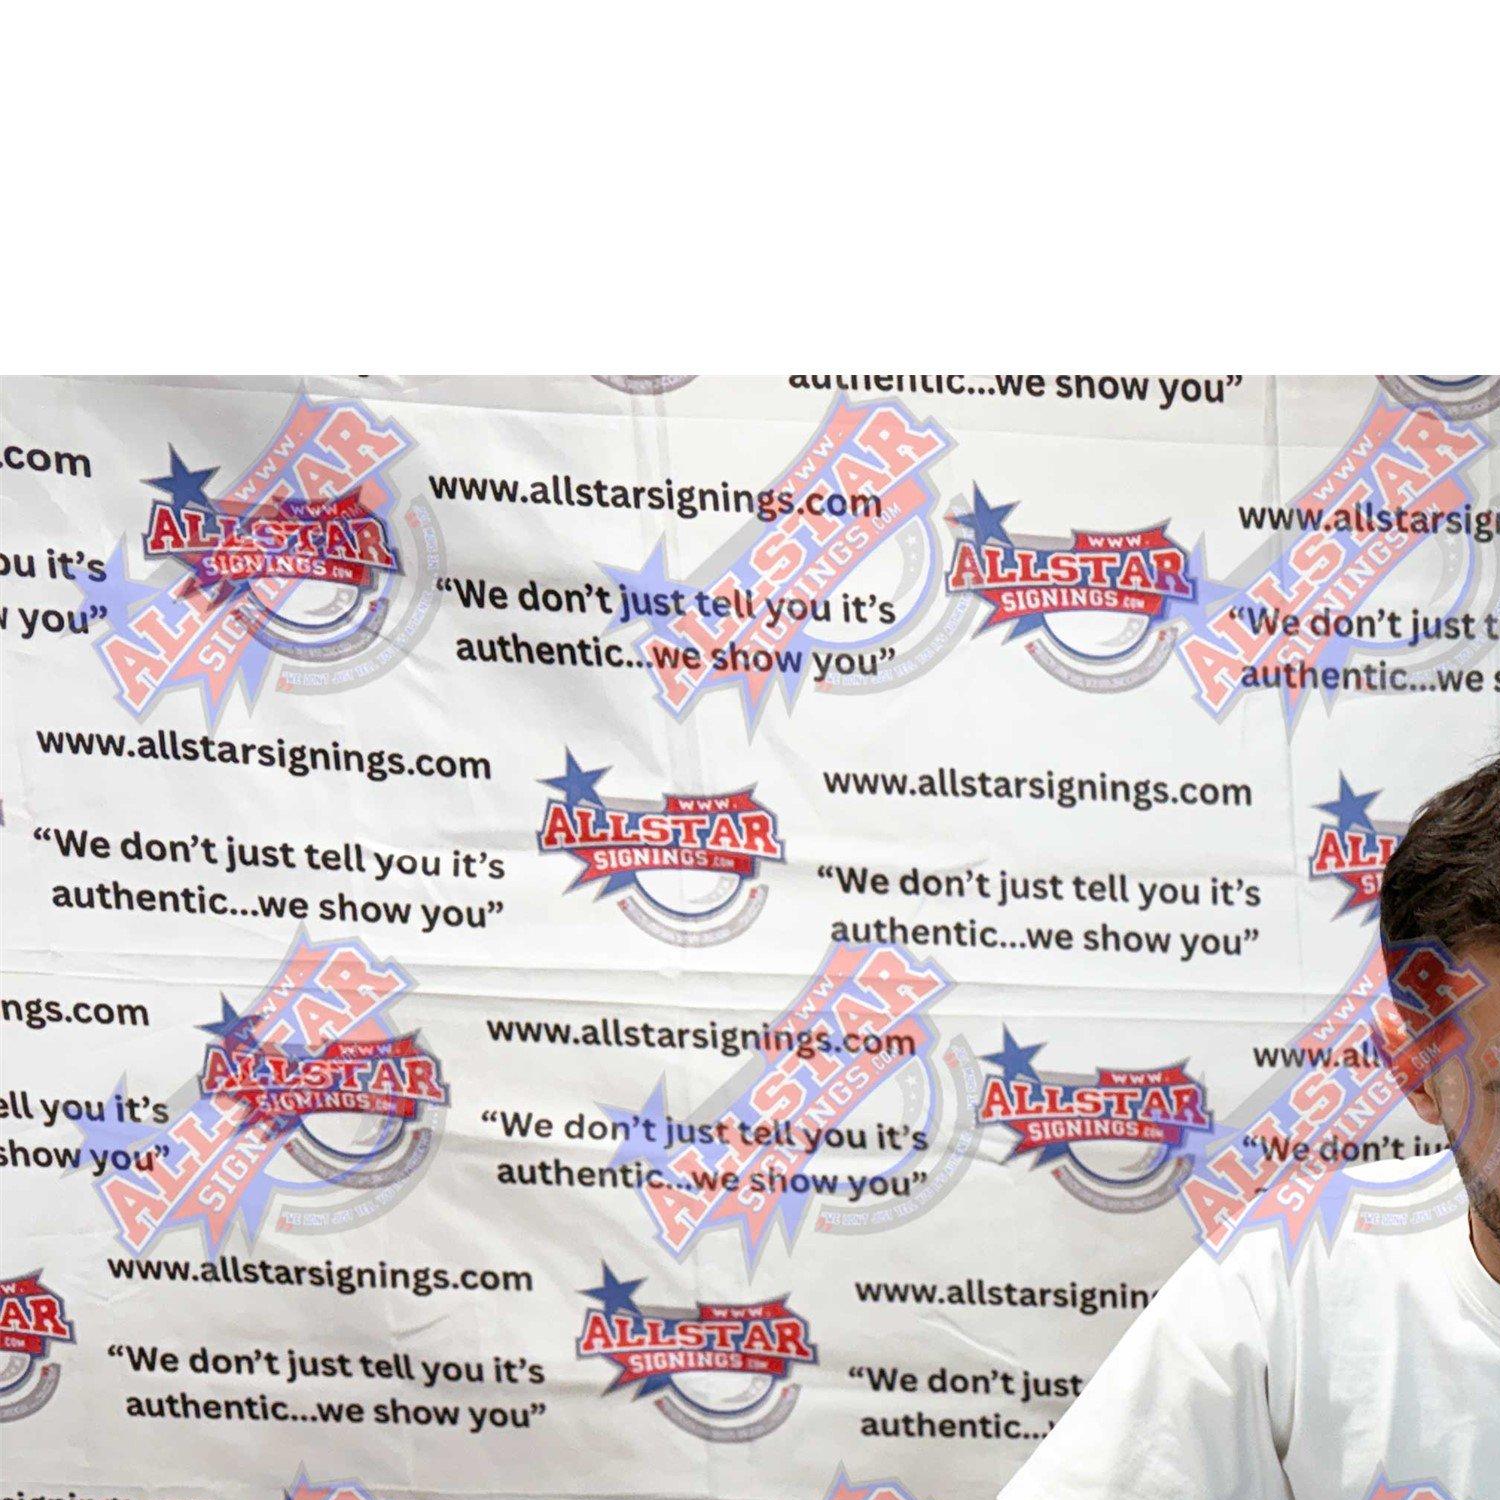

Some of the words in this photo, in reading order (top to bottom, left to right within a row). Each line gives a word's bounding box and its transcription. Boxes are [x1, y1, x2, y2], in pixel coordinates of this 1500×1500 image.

[428, 474, 882, 522] www.allstarsignings.com
[947, 541, 1194, 600] ALLSTAR
[823, 767, 1252, 811] www.allstarsignings.com
[541, 803, 782, 858] ALLSTAR
[998, 875, 1063, 906] just
[1072, 874, 1129, 902] tell
[1138, 882, 1199, 911] you
[1084, 923, 1171, 953] show
[978, 1076, 1211, 1131] ALLSTAR
[107, 1255, 533, 1297] www.allstarsignings.com
[579, 1312, 813, 1361] ALLSTAR
[286, 1349, 353, 1384] just
[358, 1353, 416, 1381] tell
[421, 1361, 485, 1389] you
